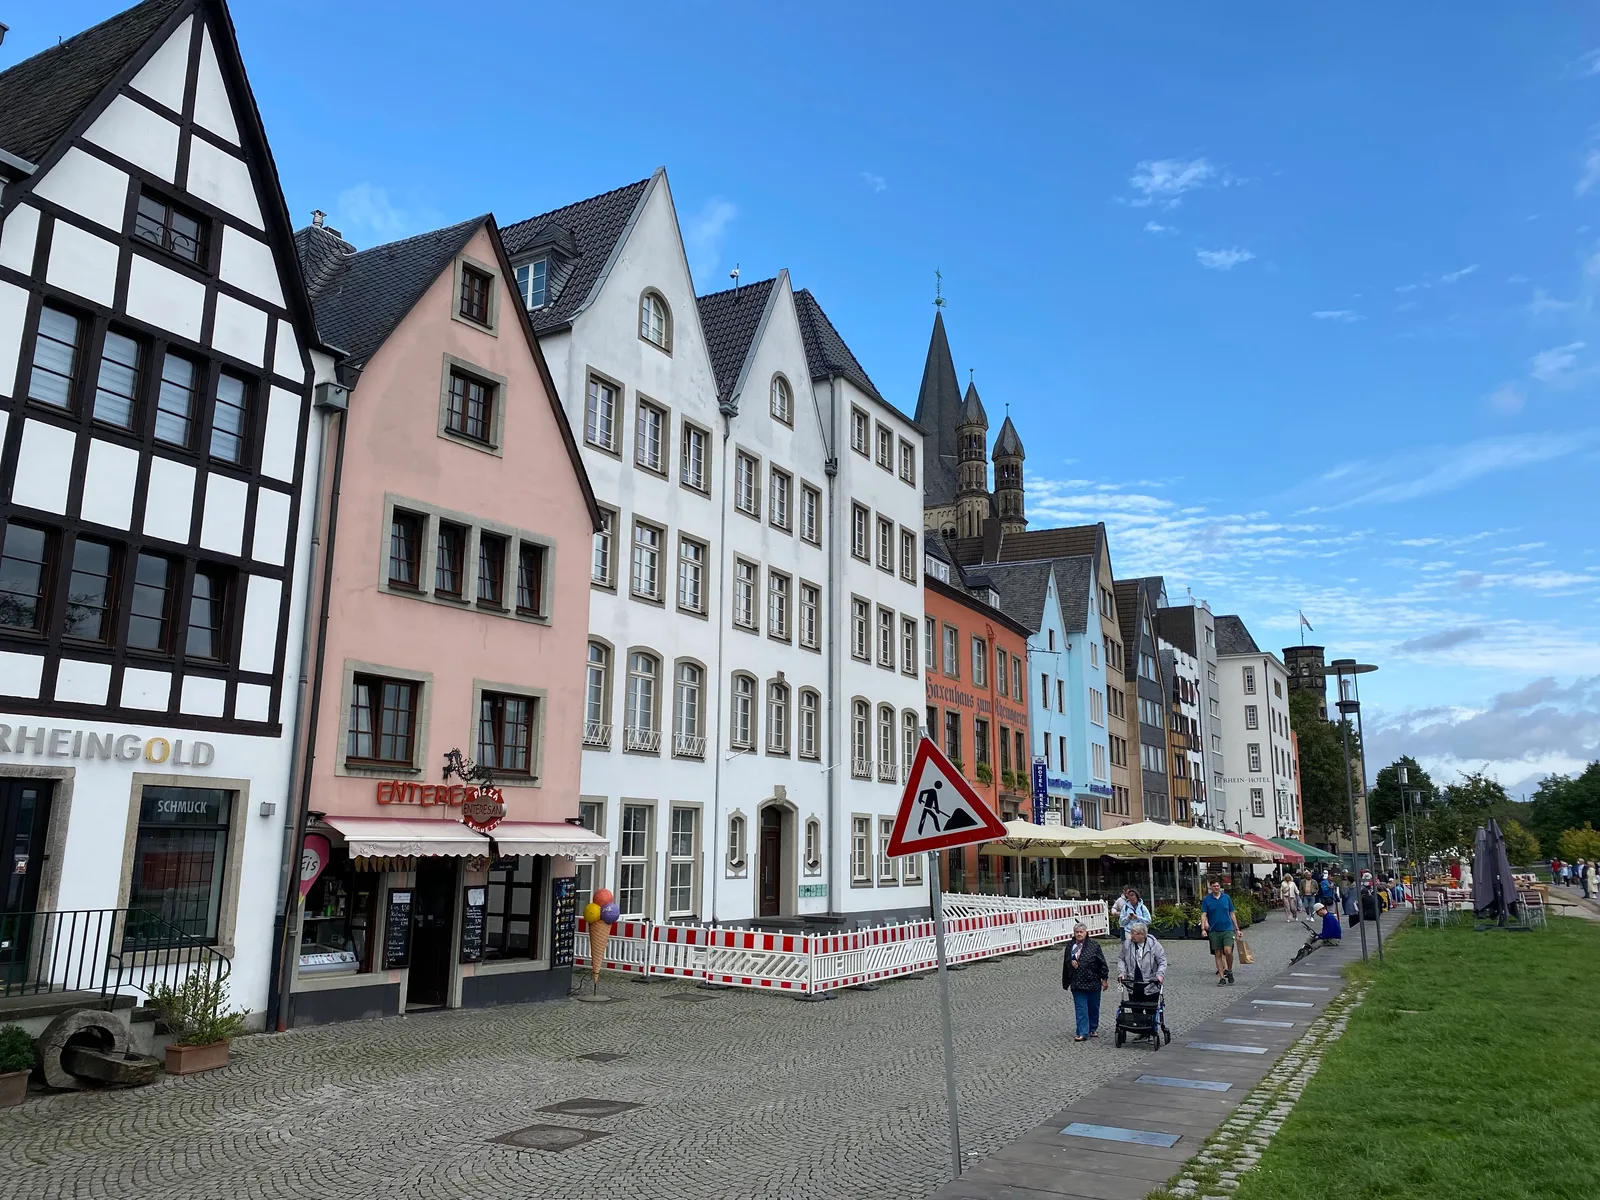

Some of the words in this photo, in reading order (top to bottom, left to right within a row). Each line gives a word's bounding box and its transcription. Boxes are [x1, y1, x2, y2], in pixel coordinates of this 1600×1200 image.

[977, 697, 992, 713] zum
[0, 723, 216, 767] RHEINGOLD
[473, 787, 499, 801] PIZZA
[157, 800, 207, 814] SCHMUCK
[463, 803, 501, 815] ENTERESAN
